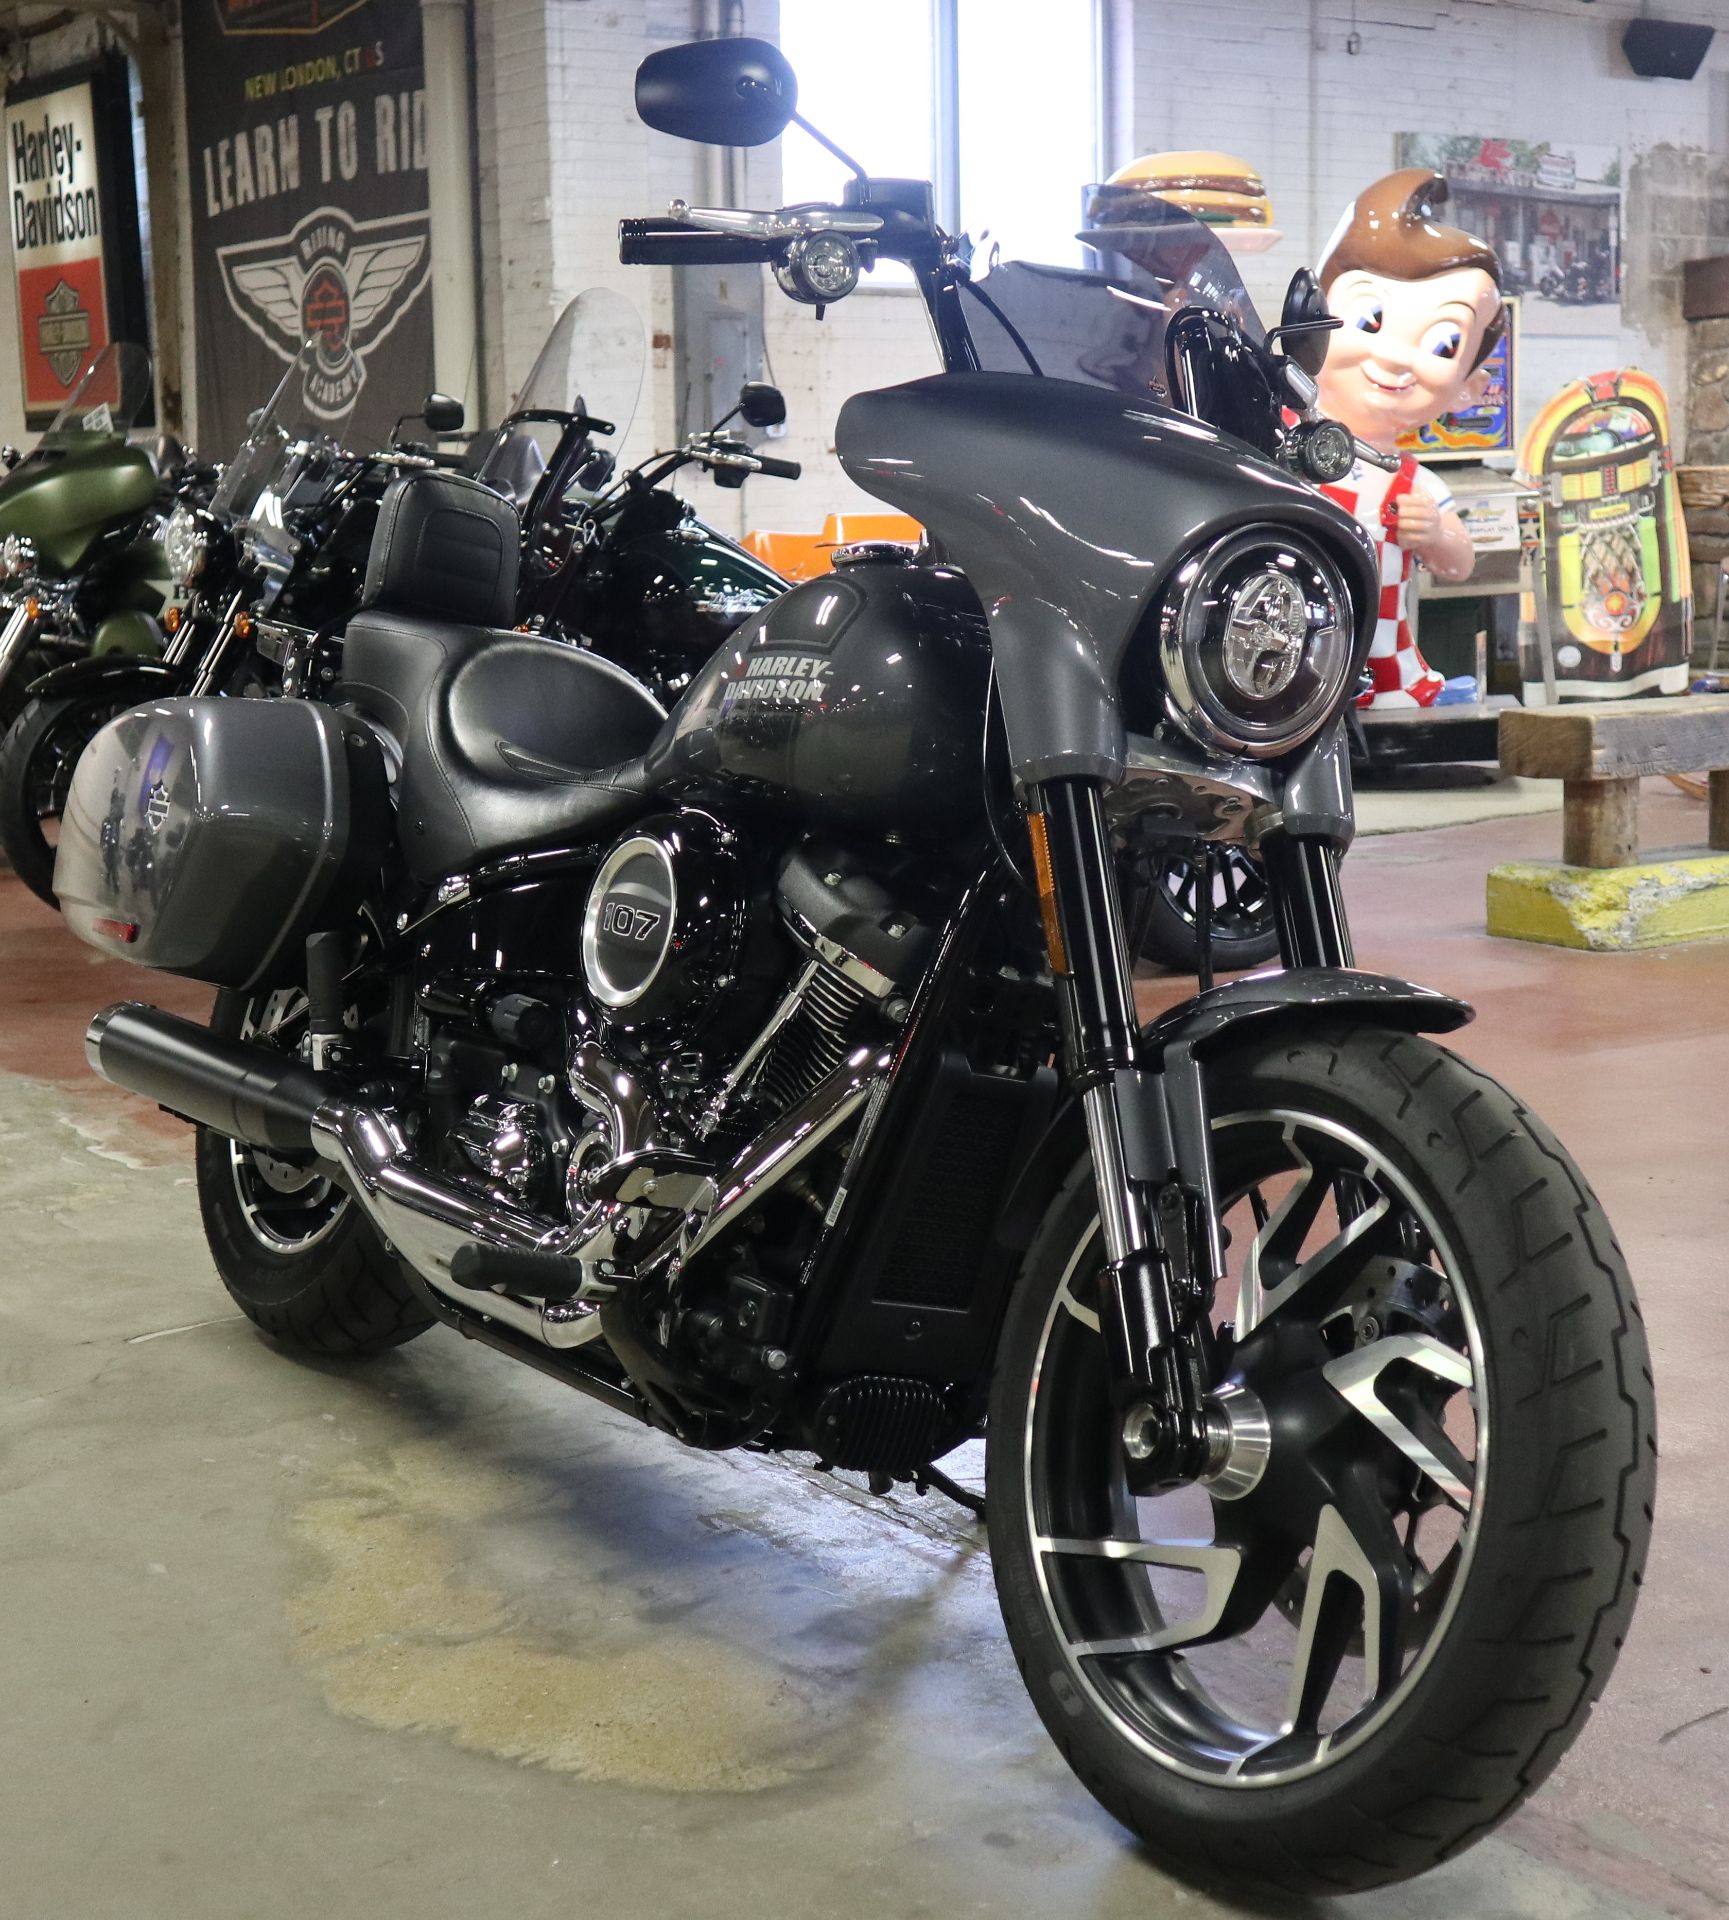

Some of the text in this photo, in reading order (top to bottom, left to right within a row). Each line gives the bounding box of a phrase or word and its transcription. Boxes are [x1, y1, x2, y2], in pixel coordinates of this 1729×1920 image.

[244, 72, 278, 100] NEW
[279, 54, 341, 92] LONDON,
[344, 47, 362, 74] CT
[12, 113, 82, 184] Harley-
[203, 89, 428, 218] LEARN TO RID
[14, 180, 98, 249] Davidson
[723, 679, 826, 701] DAVIDSON
[745, 656, 834, 678] HARLEY-
[603, 902, 661, 940] 107
